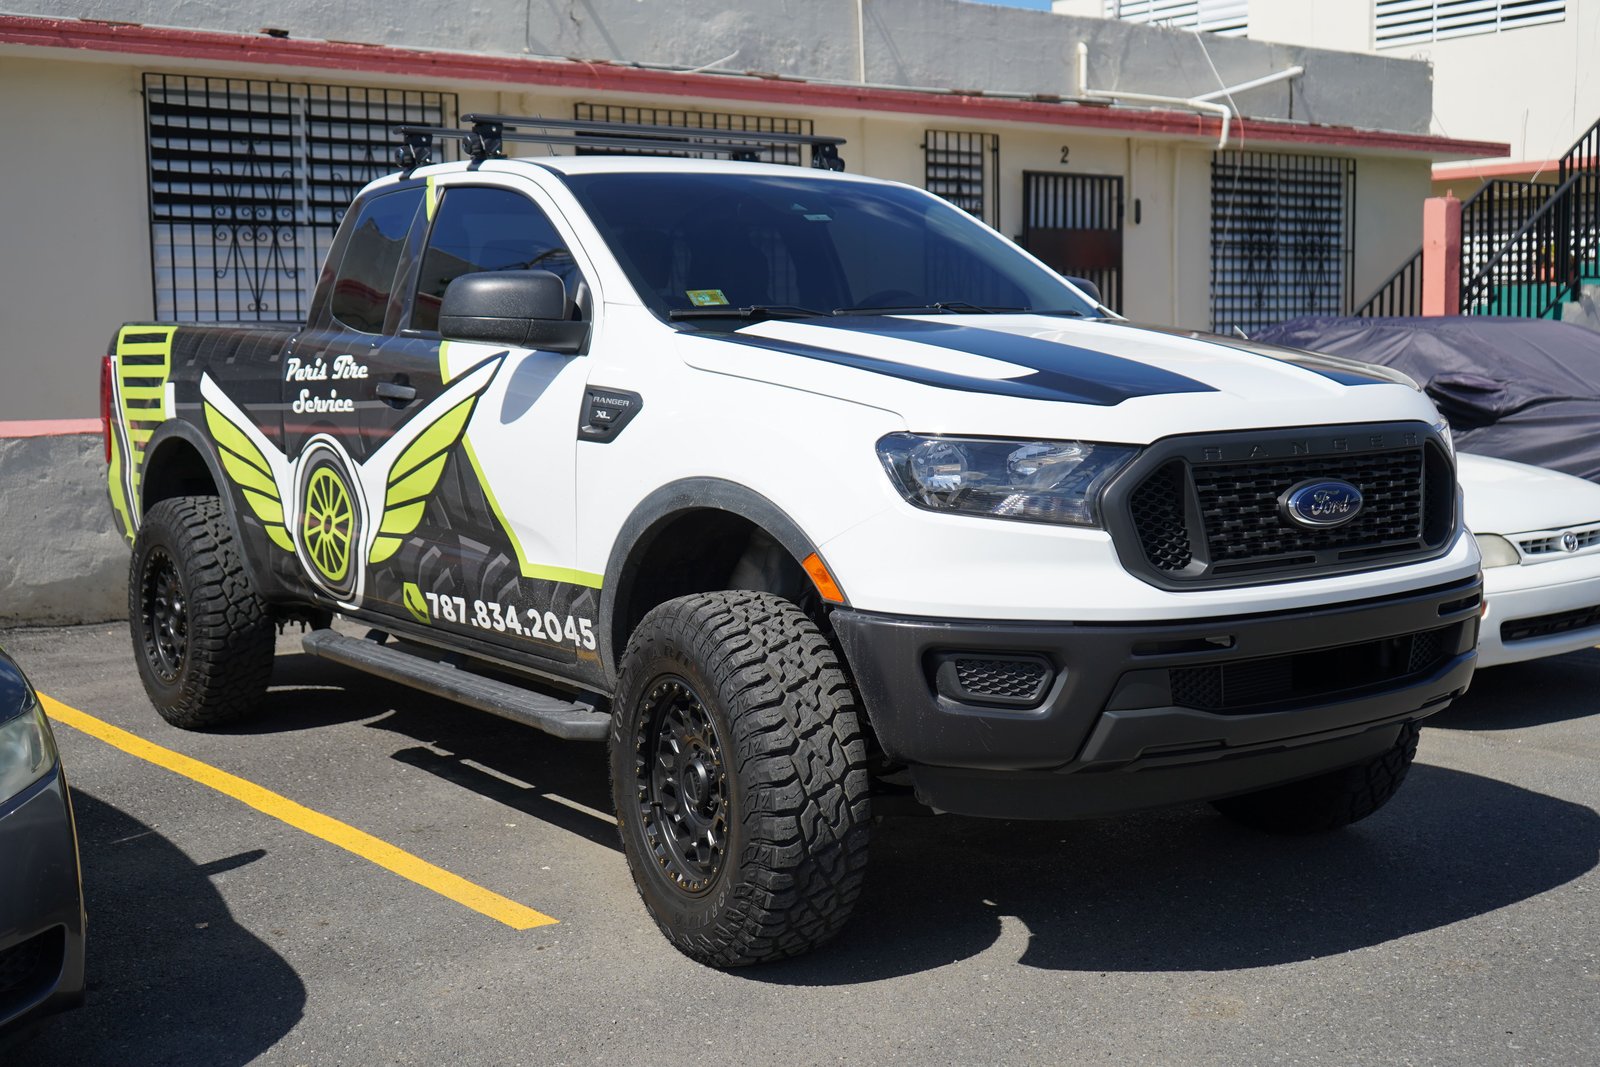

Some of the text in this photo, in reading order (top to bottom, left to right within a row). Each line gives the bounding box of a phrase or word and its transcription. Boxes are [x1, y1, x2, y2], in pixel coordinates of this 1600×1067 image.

[1060, 145, 1069, 164] 2
[332, 354, 369, 379] Tire
[292, 388, 355, 414] Service
[593, 396, 630, 406] RANGER
[595, 410, 611, 420] XL
[1203, 432, 1419, 461] RANGER
[1311, 490, 1350, 516] Ford
[425, 592, 597, 651] 787.834.2045
